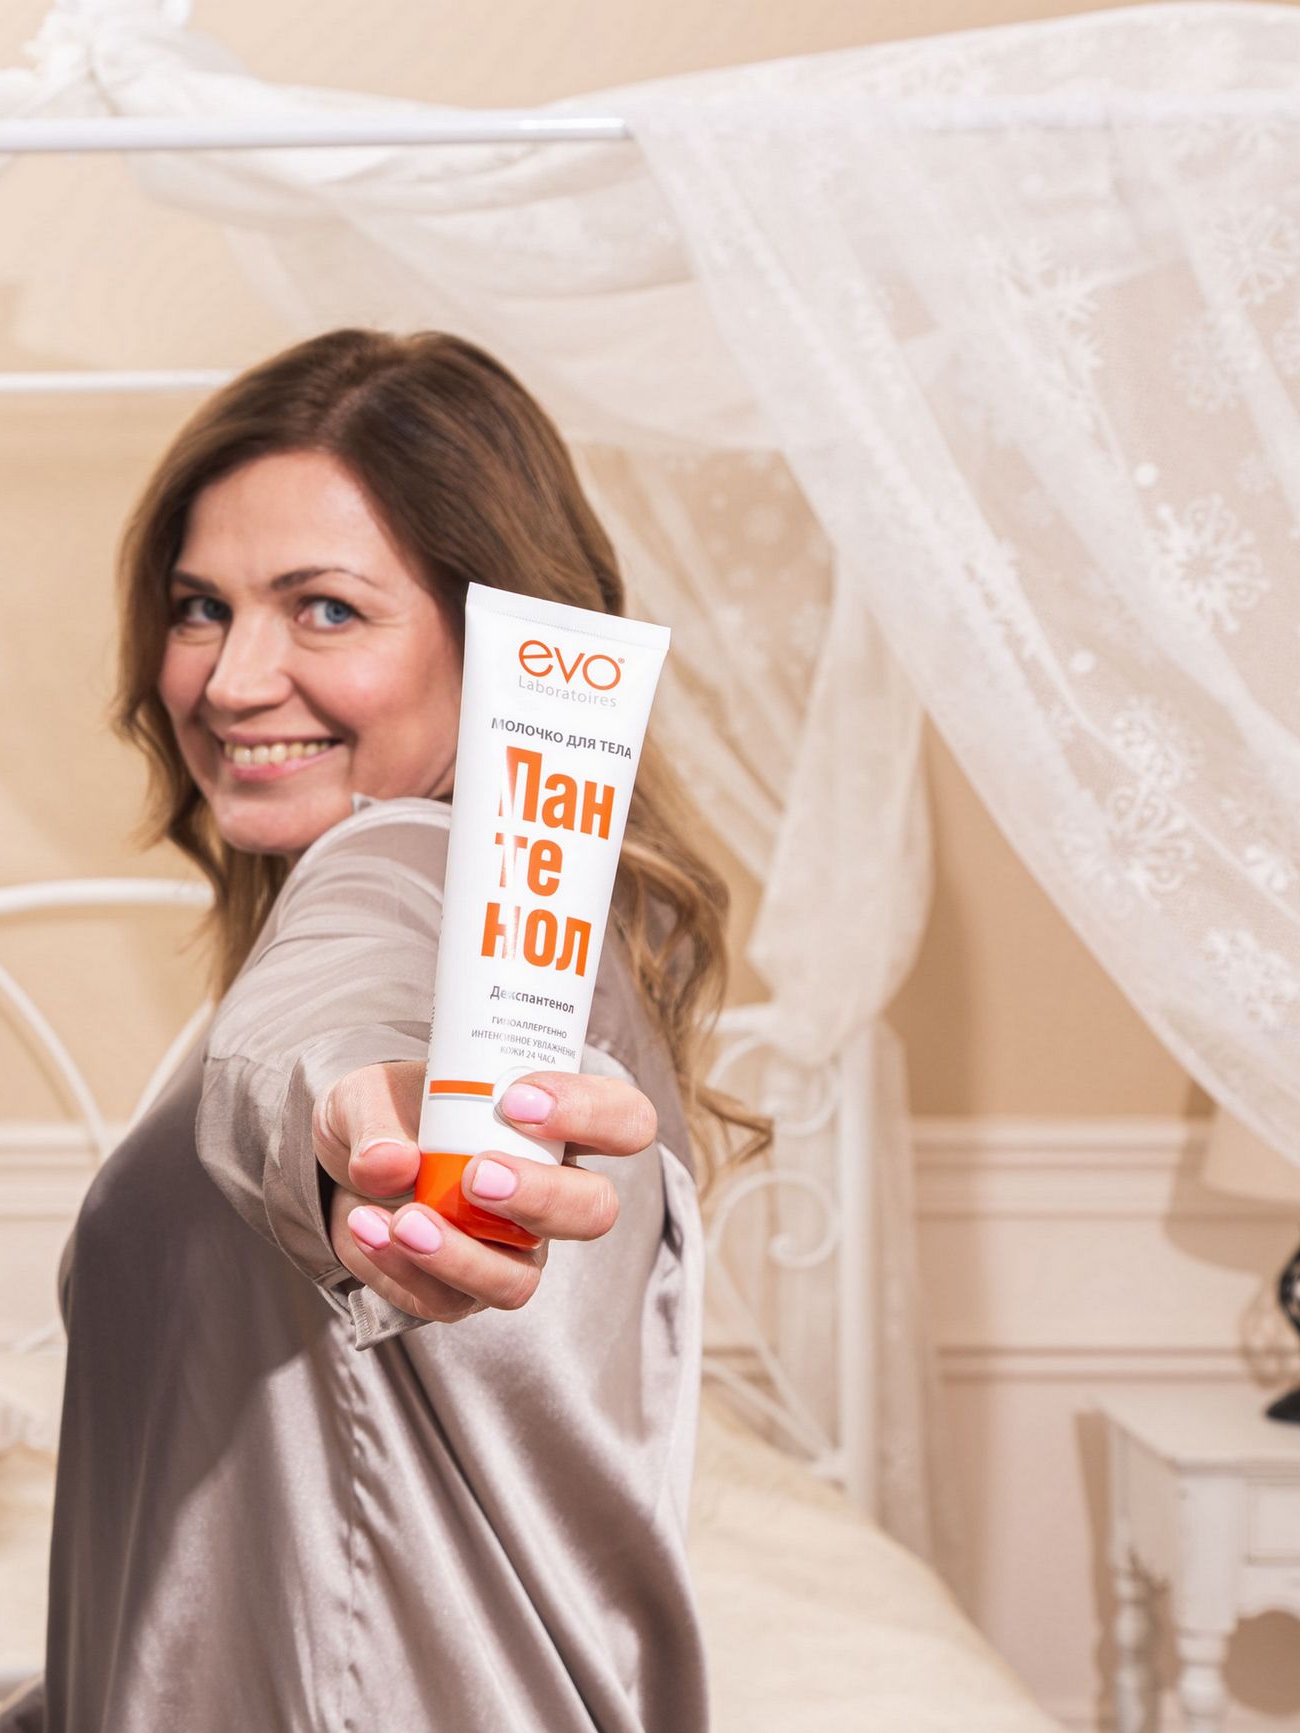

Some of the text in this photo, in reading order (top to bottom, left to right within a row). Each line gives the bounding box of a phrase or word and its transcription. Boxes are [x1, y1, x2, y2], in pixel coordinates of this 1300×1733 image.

[518, 675, 617, 707] Laboratoires
[491, 717, 632, 760] МОЛОЧКО ДЛЯ ТЕЛА
[498, 745, 616, 841] Пан
[481, 901, 592, 977] нол
[526, 1050, 536, 1059] 24
[537, 1052, 556, 1065] ЧАСА
[532, 1039, 577, 1059] УВЛАЖНЕНИЕ
